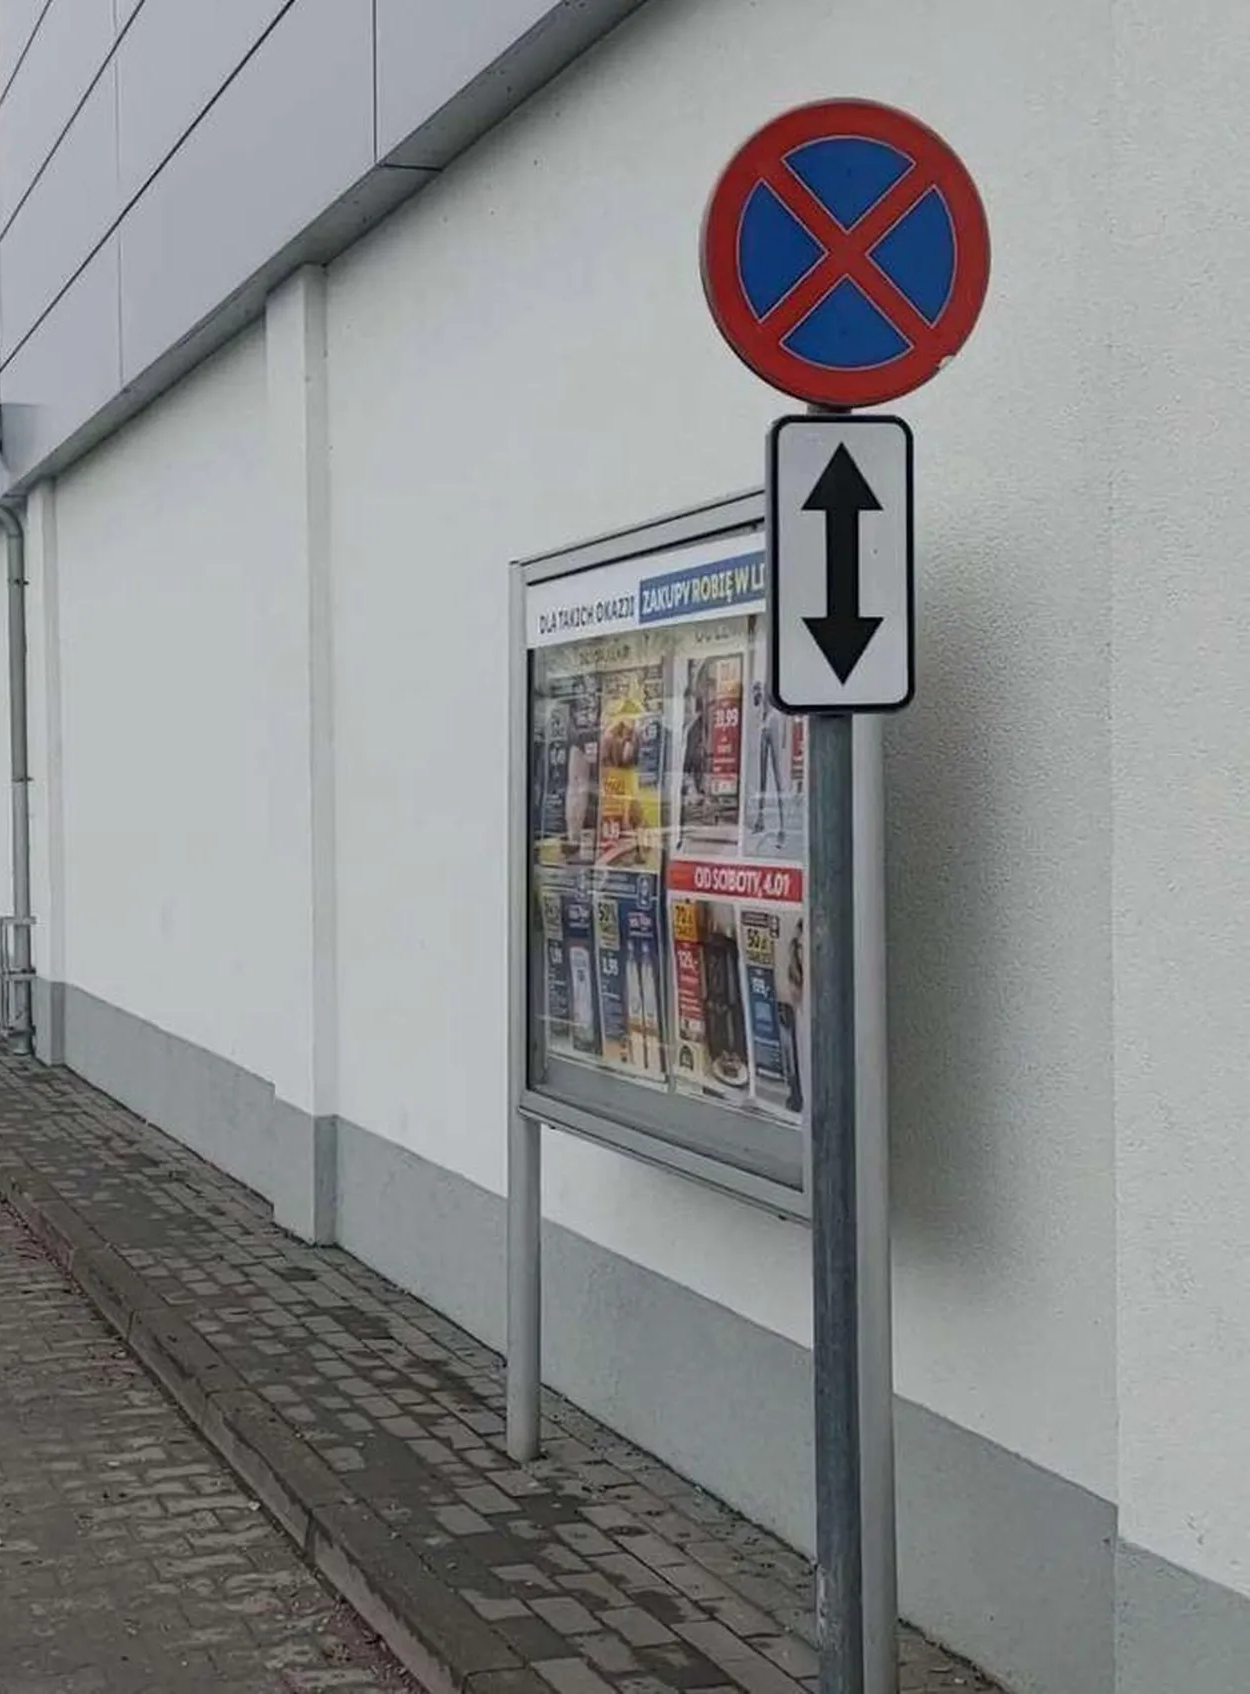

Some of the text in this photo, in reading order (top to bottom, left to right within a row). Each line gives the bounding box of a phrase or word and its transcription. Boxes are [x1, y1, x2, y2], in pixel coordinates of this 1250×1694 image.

[641, 580, 691, 615] ZAKUPY
[691, 570, 734, 602] ROBIĘ
[733, 566, 751, 594] W
[539, 594, 635, 635] DLA TAKICH OKAZJI
[694, 866, 711, 889] OD
